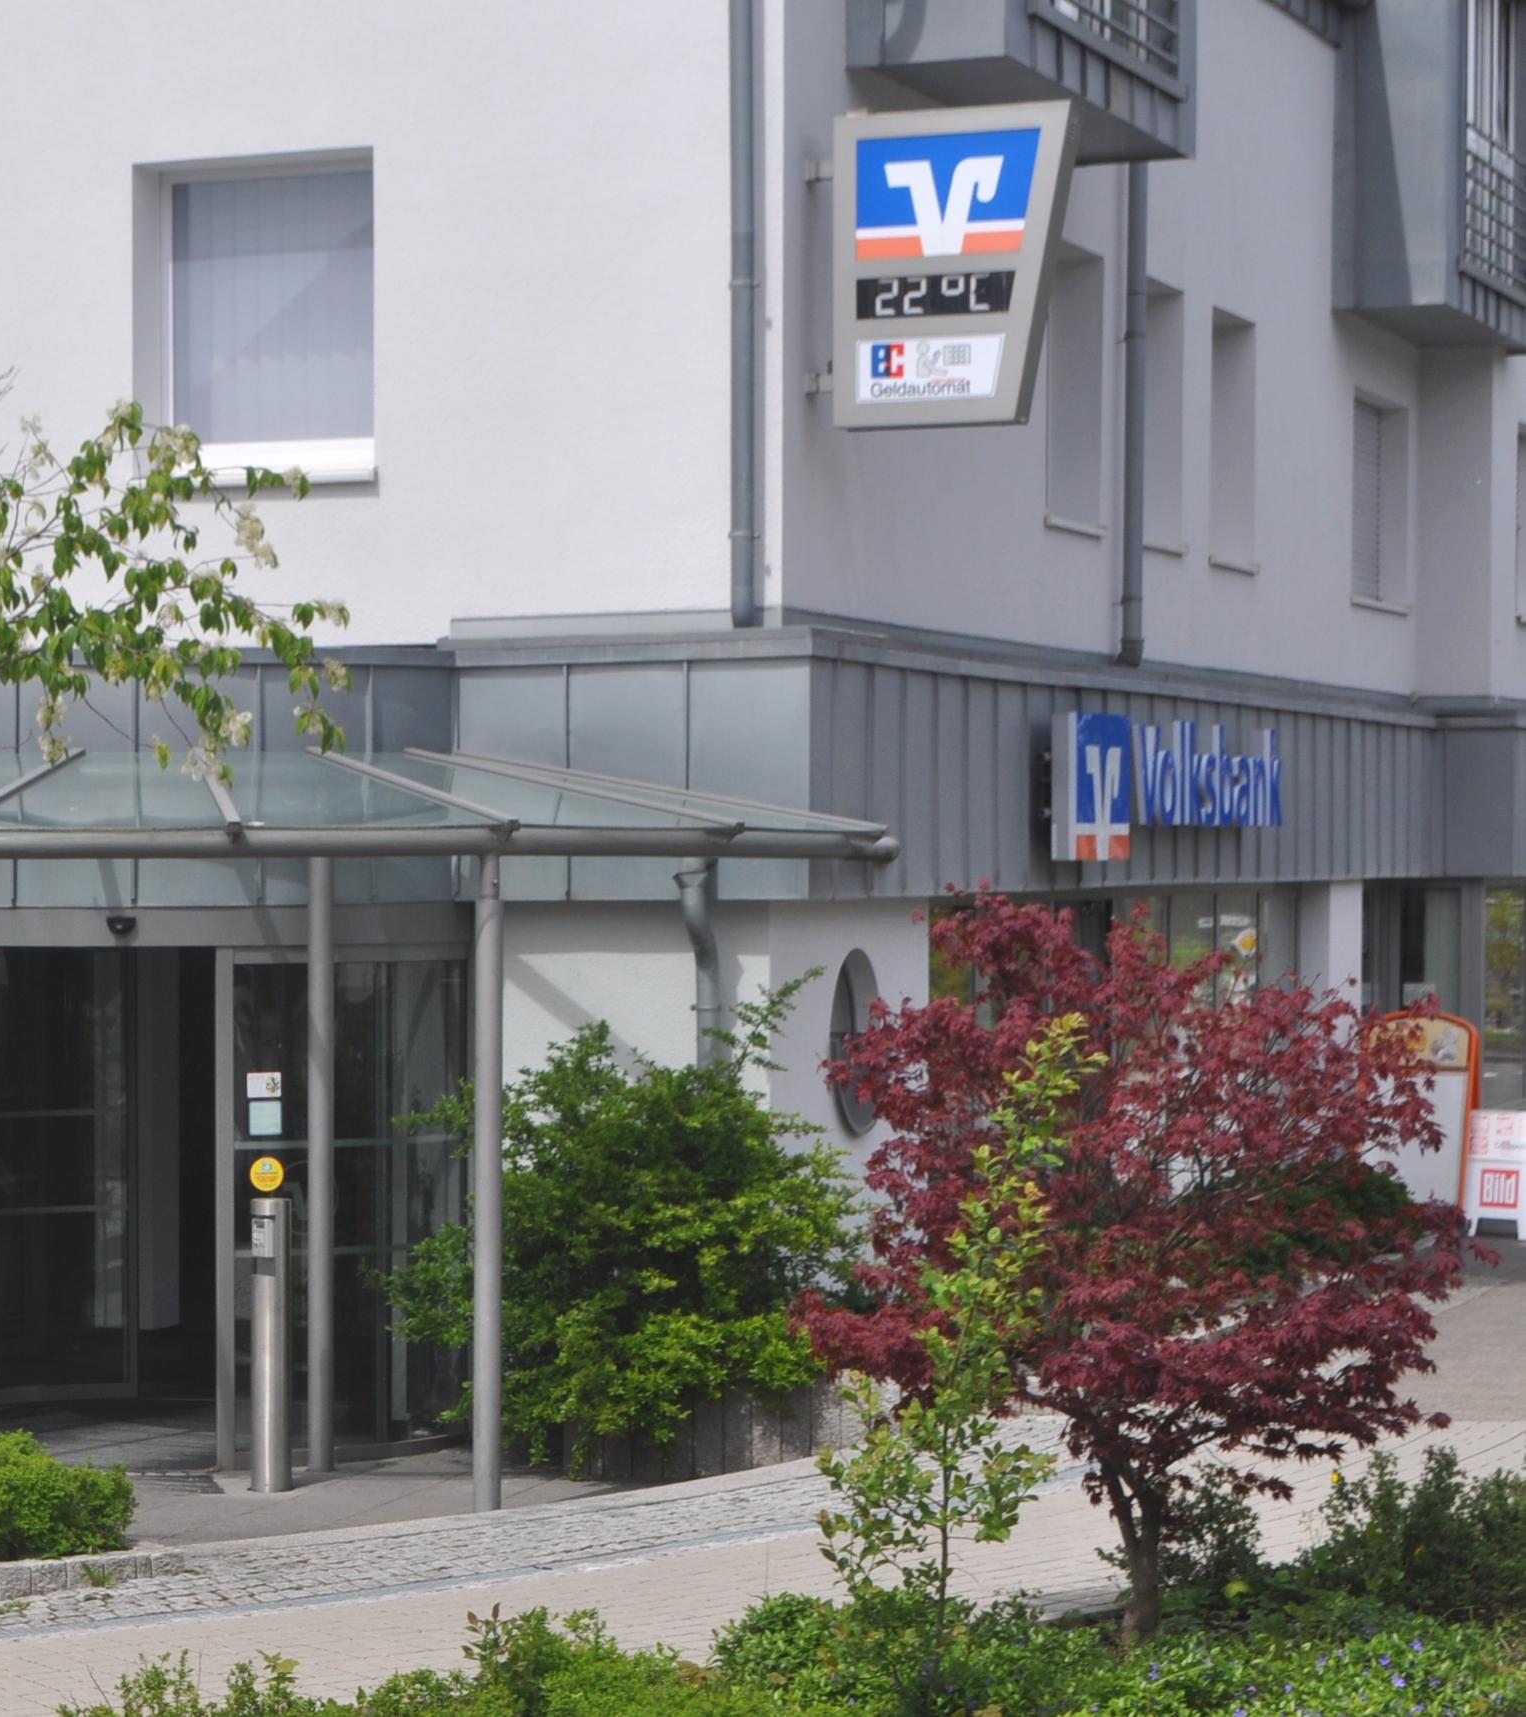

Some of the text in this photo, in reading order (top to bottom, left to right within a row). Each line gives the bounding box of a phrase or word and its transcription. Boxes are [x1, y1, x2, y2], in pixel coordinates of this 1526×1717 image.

[874, 275, 928, 317] 22
[870, 379, 971, 398] Geldautomat
[1134, 720, 1283, 827] Volksbank
